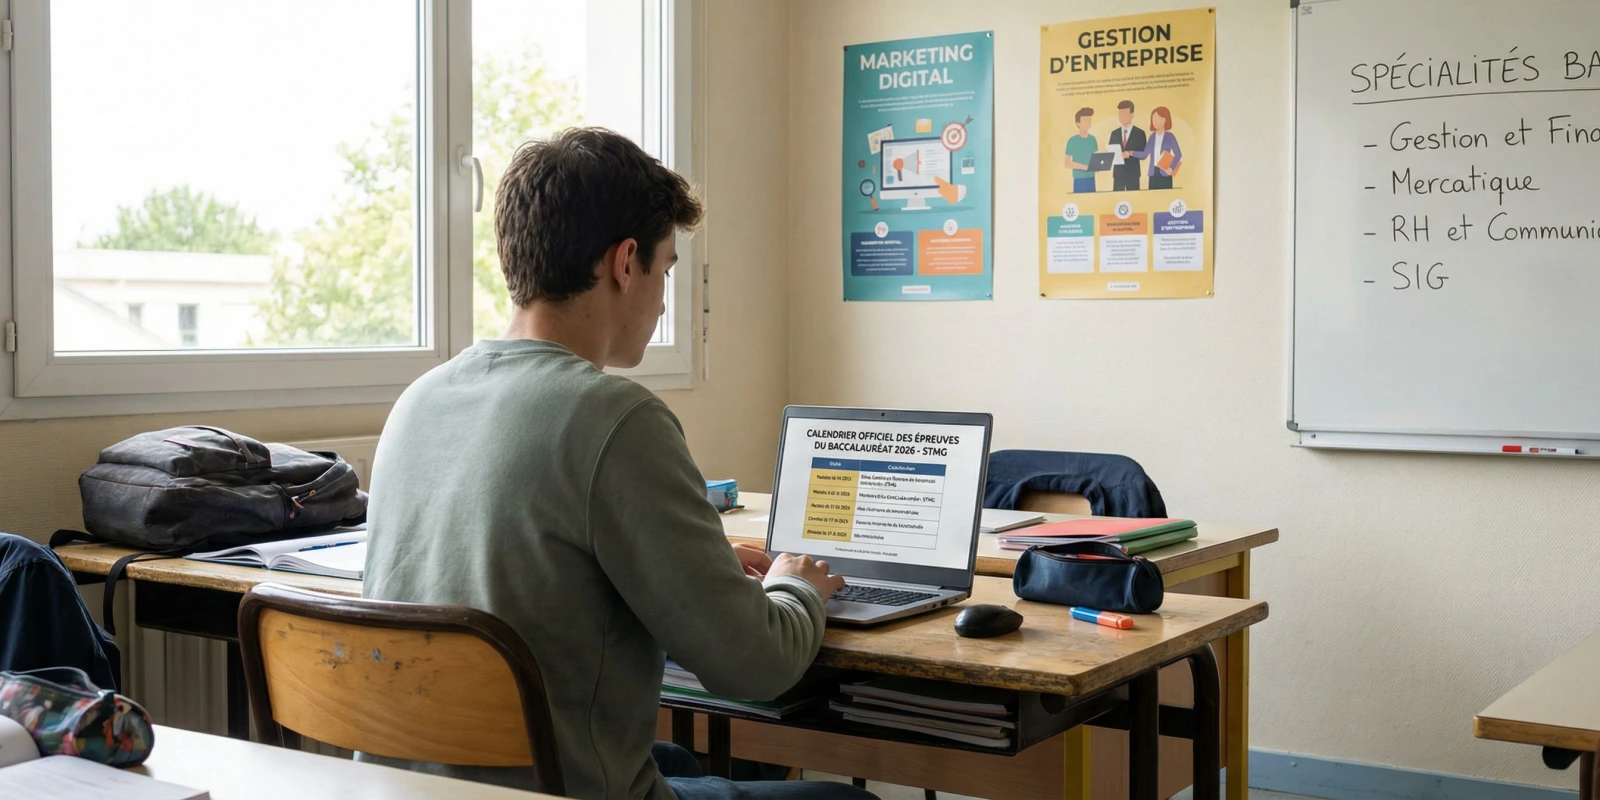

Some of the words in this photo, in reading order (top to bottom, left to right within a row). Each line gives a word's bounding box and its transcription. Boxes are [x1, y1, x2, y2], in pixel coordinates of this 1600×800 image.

[1078, 23, 1171, 49] GESTION
[860, 44, 973, 70] MARKETING
[1050, 44, 1203, 74] D'ENTREPRISE
[879, 68, 954, 89] DIGITAL
[1390, 121, 1488, 151] Gestion
[1504, 117, 1532, 146] et
[1391, 165, 1541, 206] Mercatique
[1391, 214, 1429, 242] RH
[1447, 213, 1473, 241] et
[1392, 261, 1449, 290] SIG
[806, 429, 857, 440] CALENDRIER
[858, 431, 895, 442] OFFICIEL
[896, 433, 913, 442] DES
[914, 432, 960, 445] ÉPREUVES
[814, 441, 827, 450] DU
[828, 442, 893, 454] BACCALAURÉAT
[894, 445, 915, 455] 2026
[922, 446, 948, 457] STMG
